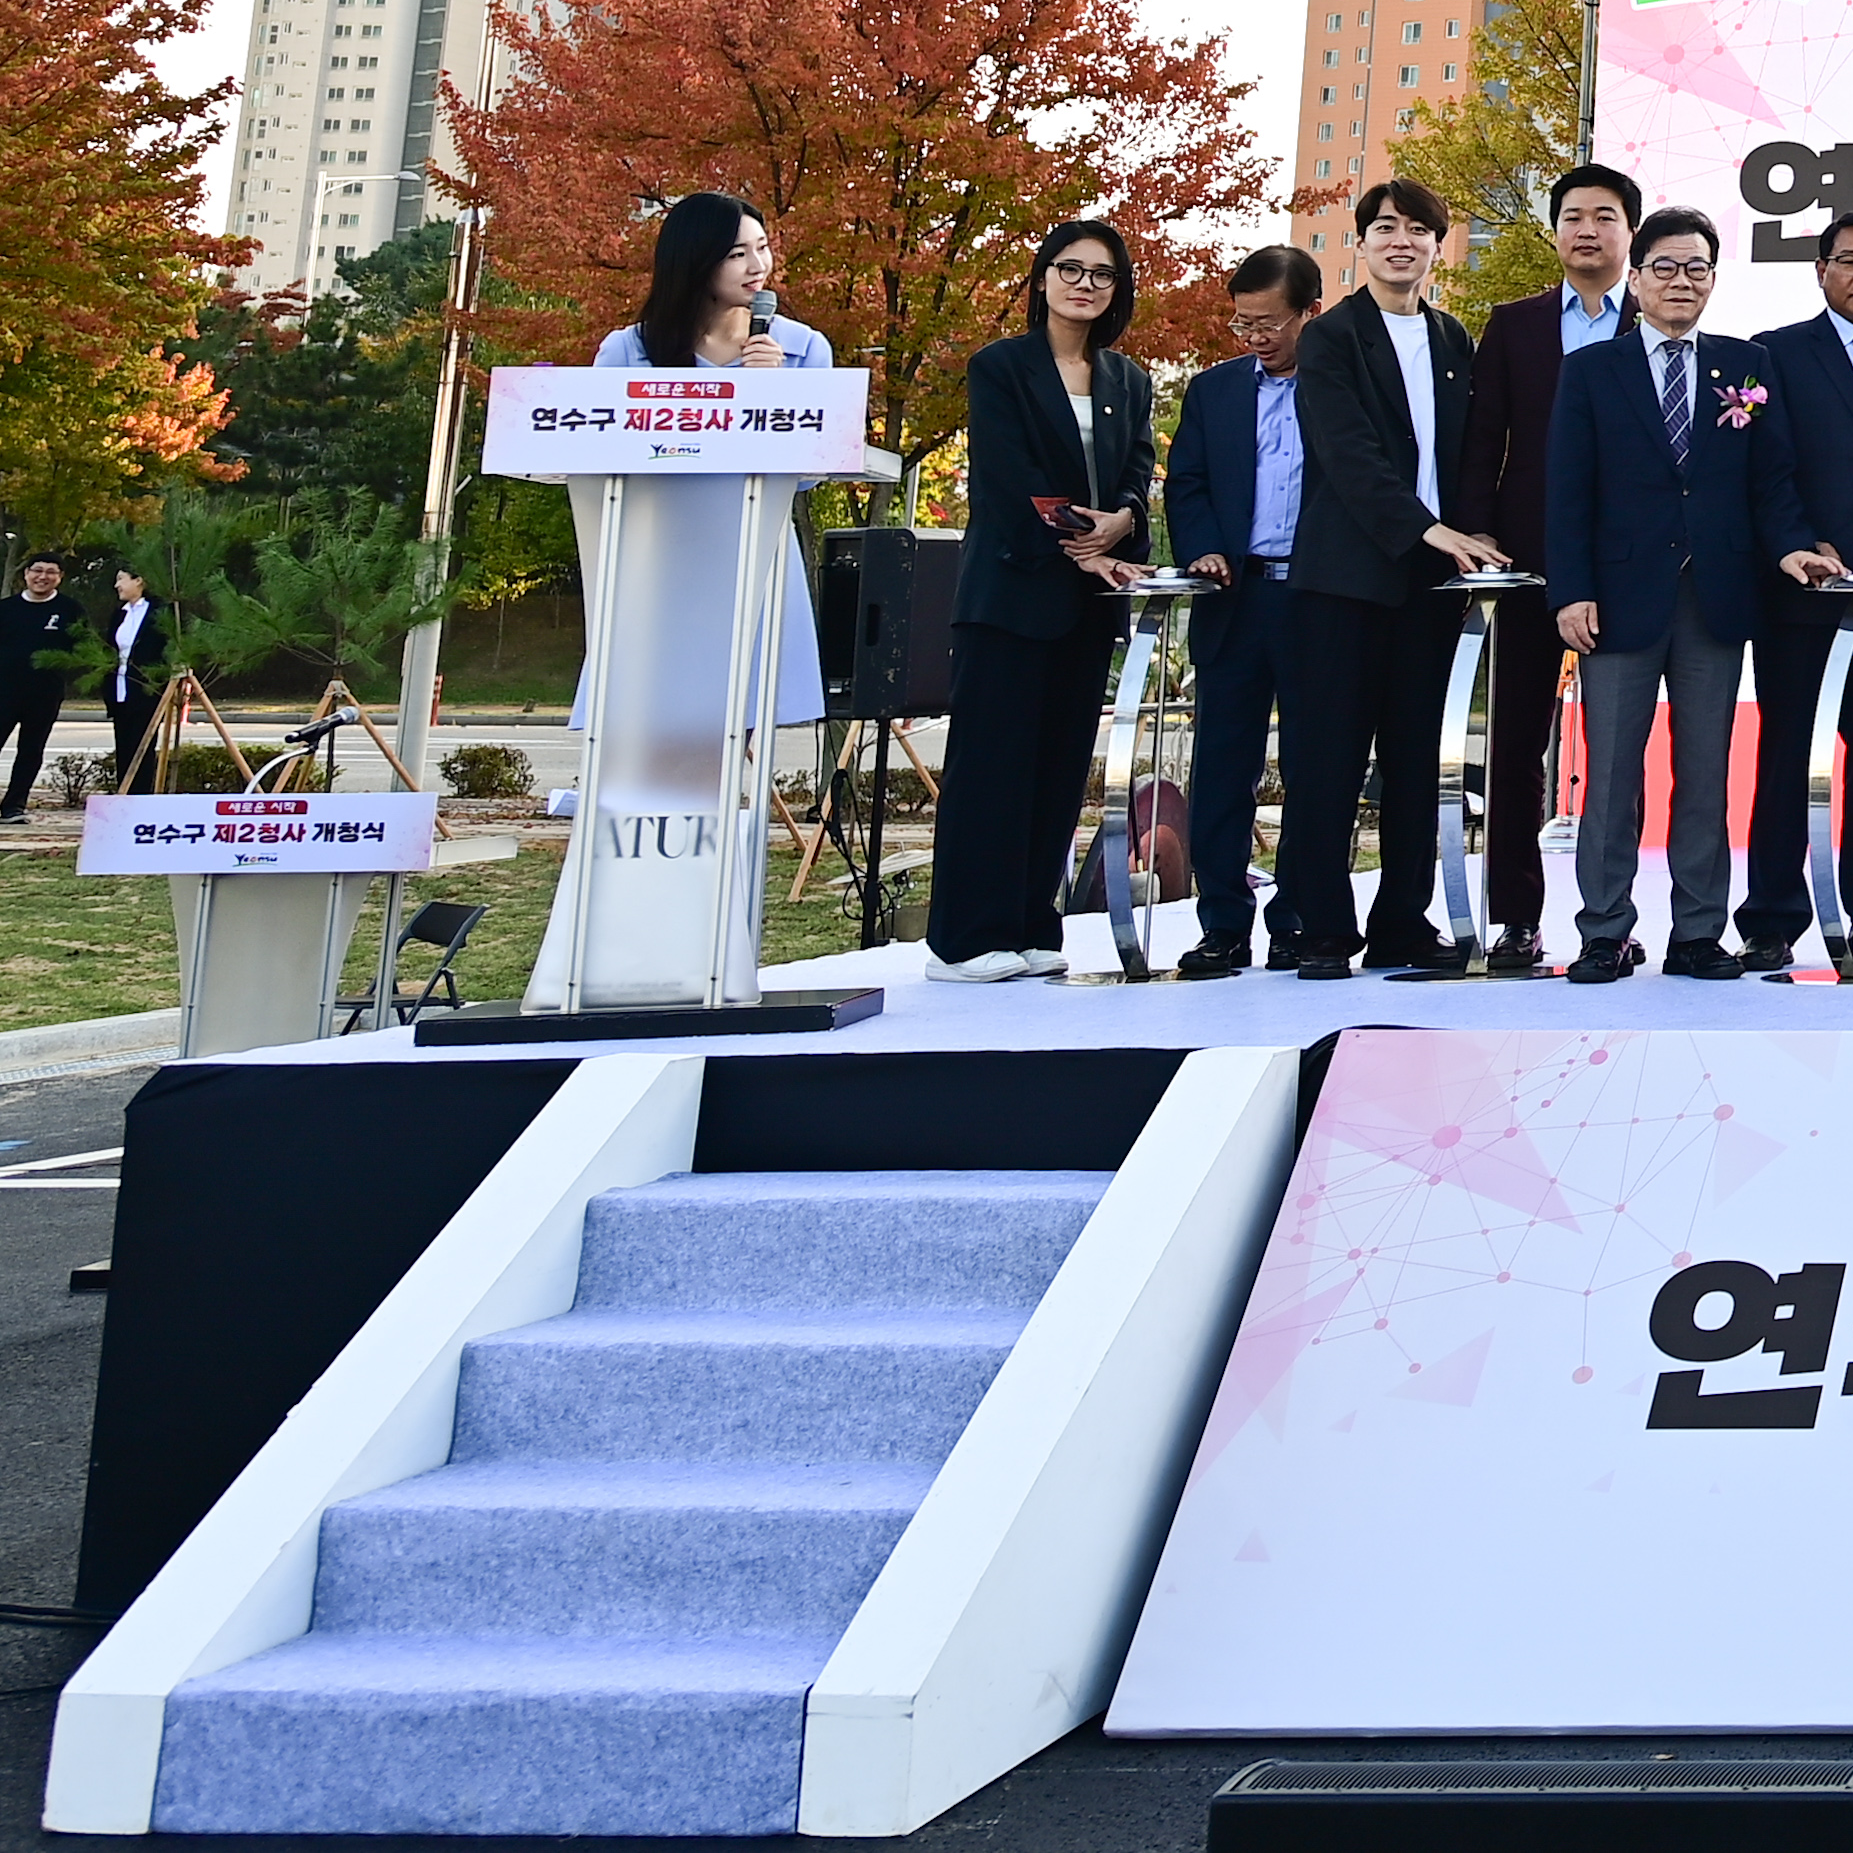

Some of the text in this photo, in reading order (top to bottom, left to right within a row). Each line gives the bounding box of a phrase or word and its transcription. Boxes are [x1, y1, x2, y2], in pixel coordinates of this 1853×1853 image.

[641, 383, 721, 397] 새로운 시작
[531, 407, 825, 433] 연수구 제2청사 개청식
[650, 444, 700, 457] Yeonsu
[228, 801, 297, 814] 새로운 시작
[133, 822, 386, 844] 연수구 제2청사 개청식
[234, 853, 278, 866] Yeonsu
